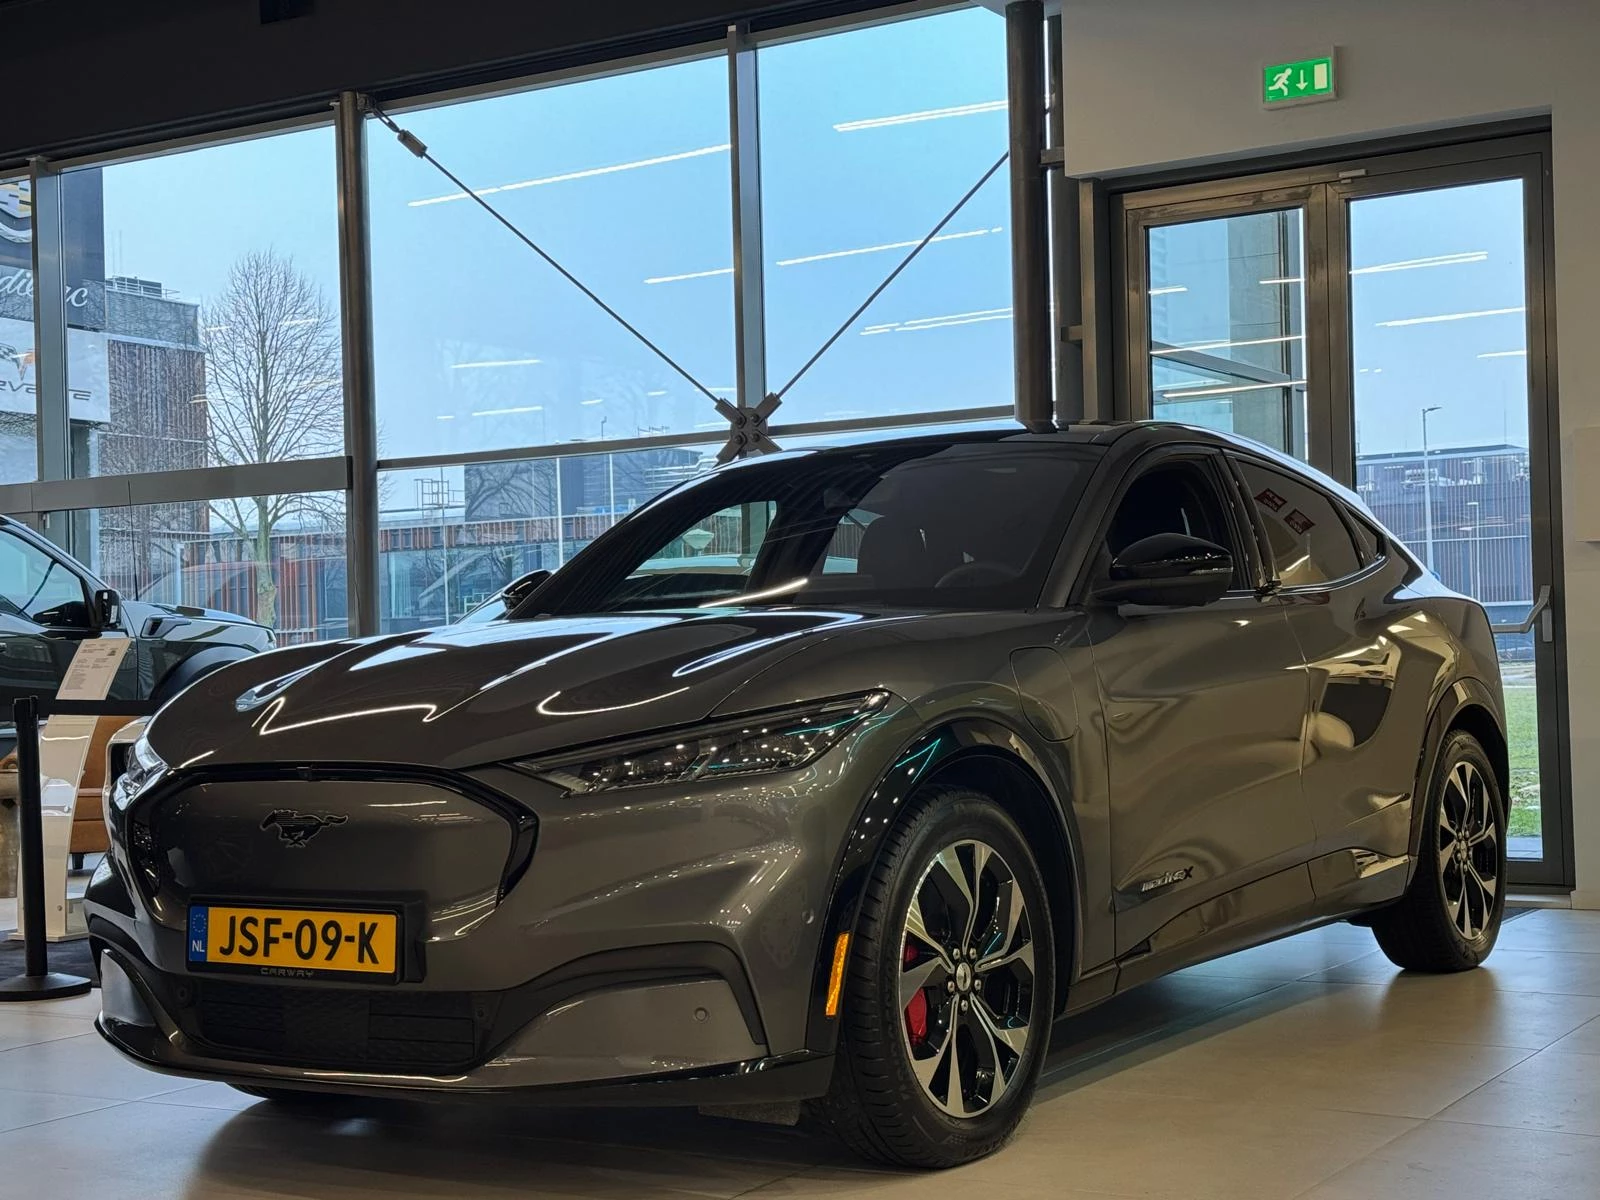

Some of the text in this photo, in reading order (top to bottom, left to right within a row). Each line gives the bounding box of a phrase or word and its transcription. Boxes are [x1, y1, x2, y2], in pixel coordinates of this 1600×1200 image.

[219, 915, 380, 964] JSF-09-K
[192, 940, 205, 952] NL
[260, 967, 314, 978] CARWAY
